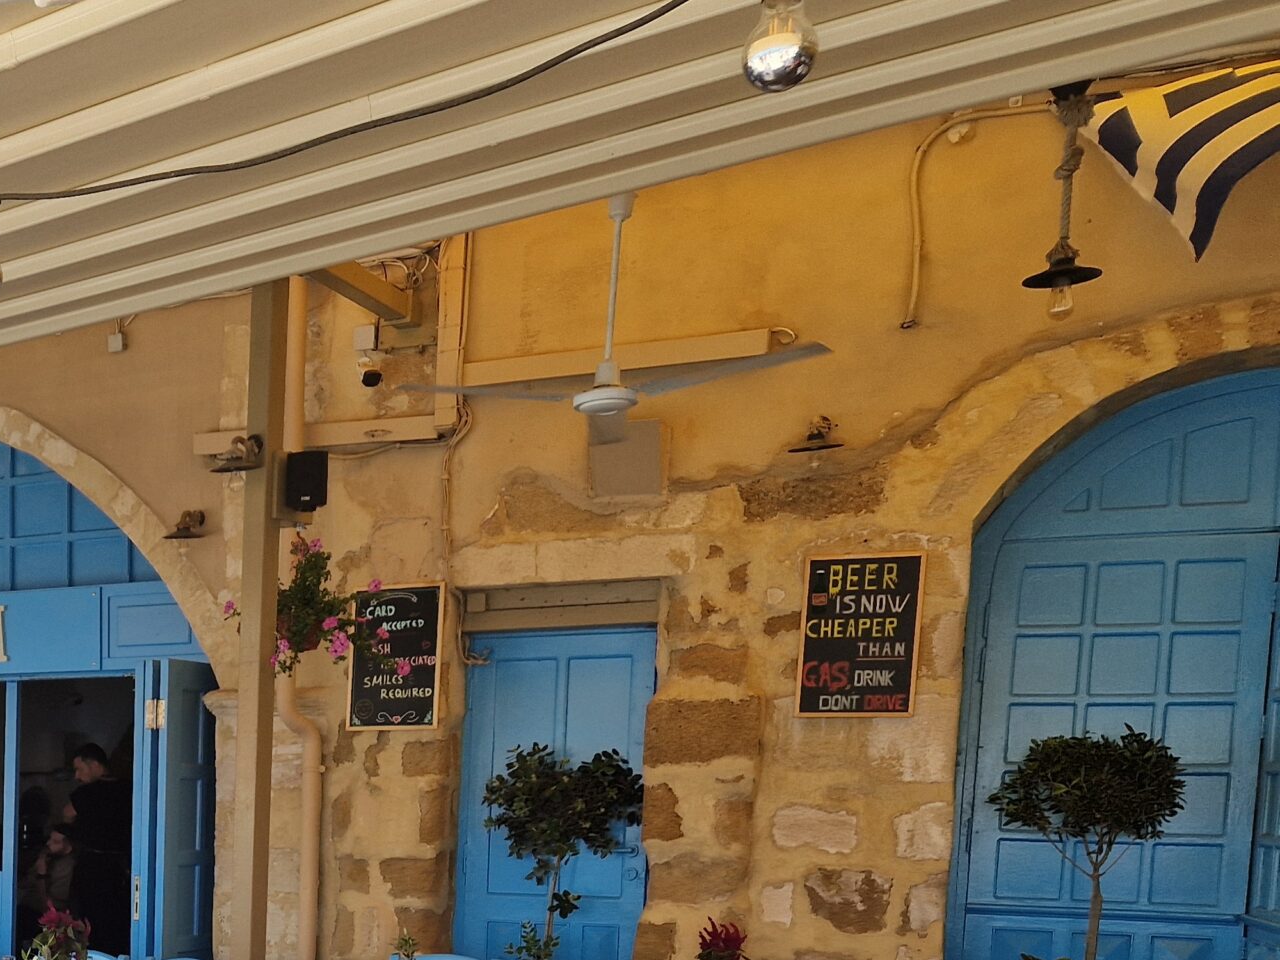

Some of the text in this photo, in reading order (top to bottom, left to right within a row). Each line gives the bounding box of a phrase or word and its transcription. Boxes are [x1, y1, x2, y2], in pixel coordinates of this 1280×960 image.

[829, 564, 898, 597] BEER
[836, 593, 911, 614] IS NOW
[366, 605, 396, 619] CARD
[382, 619, 425, 631] ACCEPTED
[806, 618, 898, 638] CHEAPER
[857, 642, 906, 657] THAN
[363, 675, 404, 688] SMILES
[854, 669, 895, 687] DRINK
[380, 688, 433, 700] REQUIRED
[864, 695, 906, 710] DRIVE
